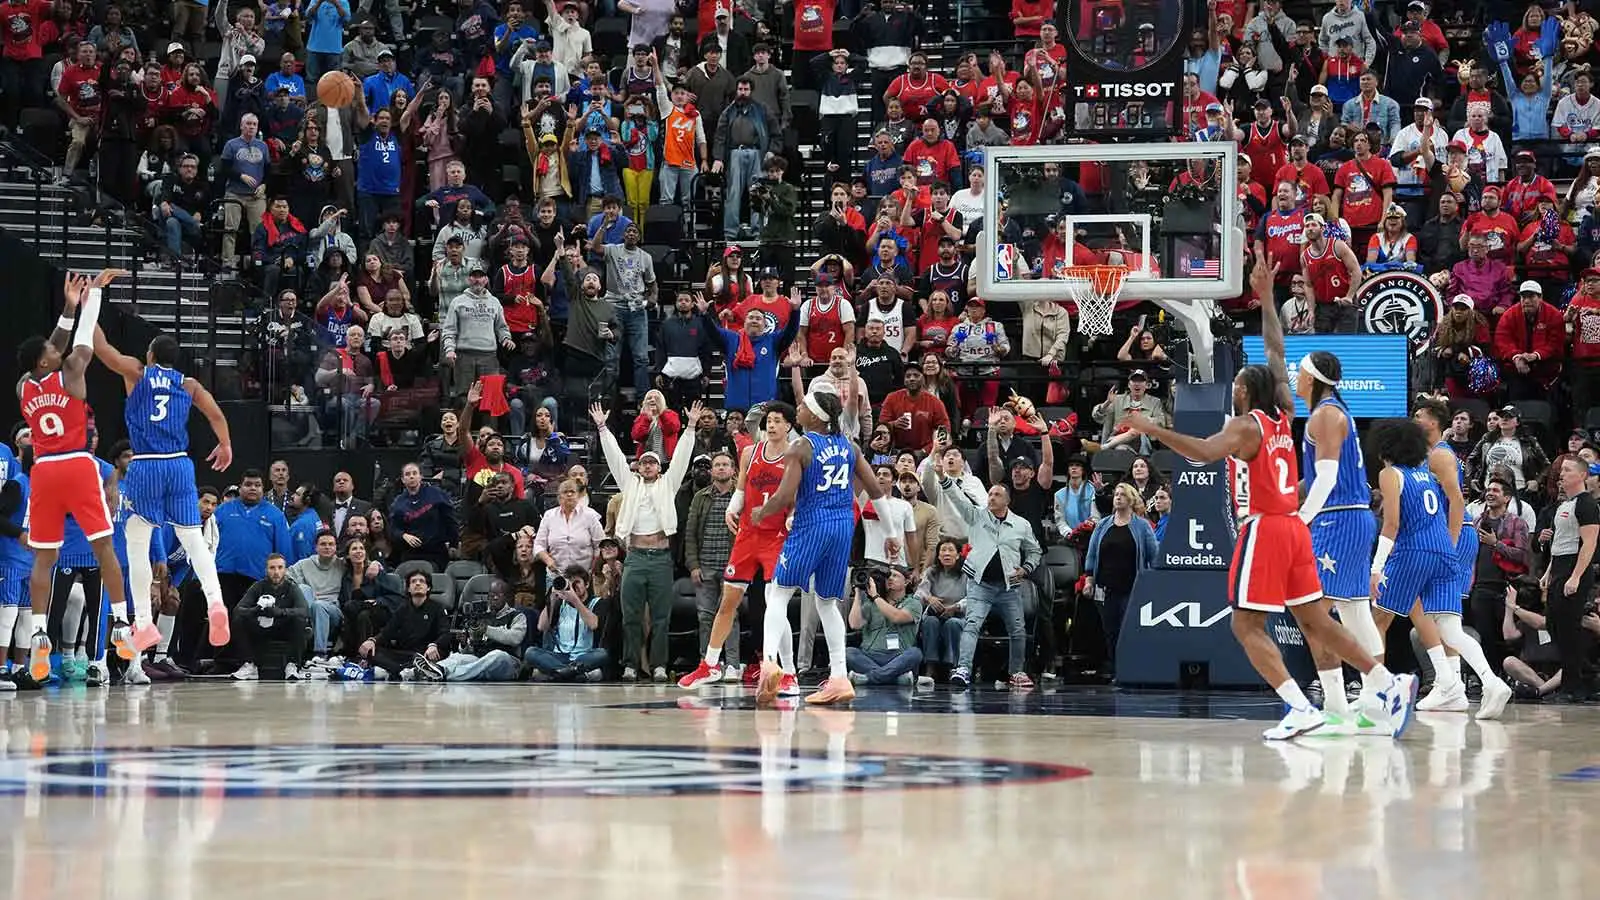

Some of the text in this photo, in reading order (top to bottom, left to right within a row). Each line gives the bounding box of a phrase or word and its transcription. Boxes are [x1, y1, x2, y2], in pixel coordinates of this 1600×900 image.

[1074, 83, 1175, 97] T TISSOT
[672, 117, 694, 131] LA
[676, 130, 685, 142] 2
[382, 152, 390, 163] 2
[1270, 153, 1276, 165] 1
[1268, 224, 1302, 237] Clippers
[1331, 275, 1340, 287] 6
[952, 291, 959, 302] 8
[1379, 279, 1430, 303] ANGELES
[828, 331, 836, 343] 2
[886, 325, 900, 337] 55
[335, 335, 342, 345] 2
[150, 395, 170, 422] 3
[39, 412, 64, 437] 9
[816, 463, 850, 492] 34
[1178, 472, 1218, 486] AT&T
[1275, 457, 1296, 495] 2
[1423, 489, 1439, 515] 0
[1166, 553, 1227, 566] teradata.
